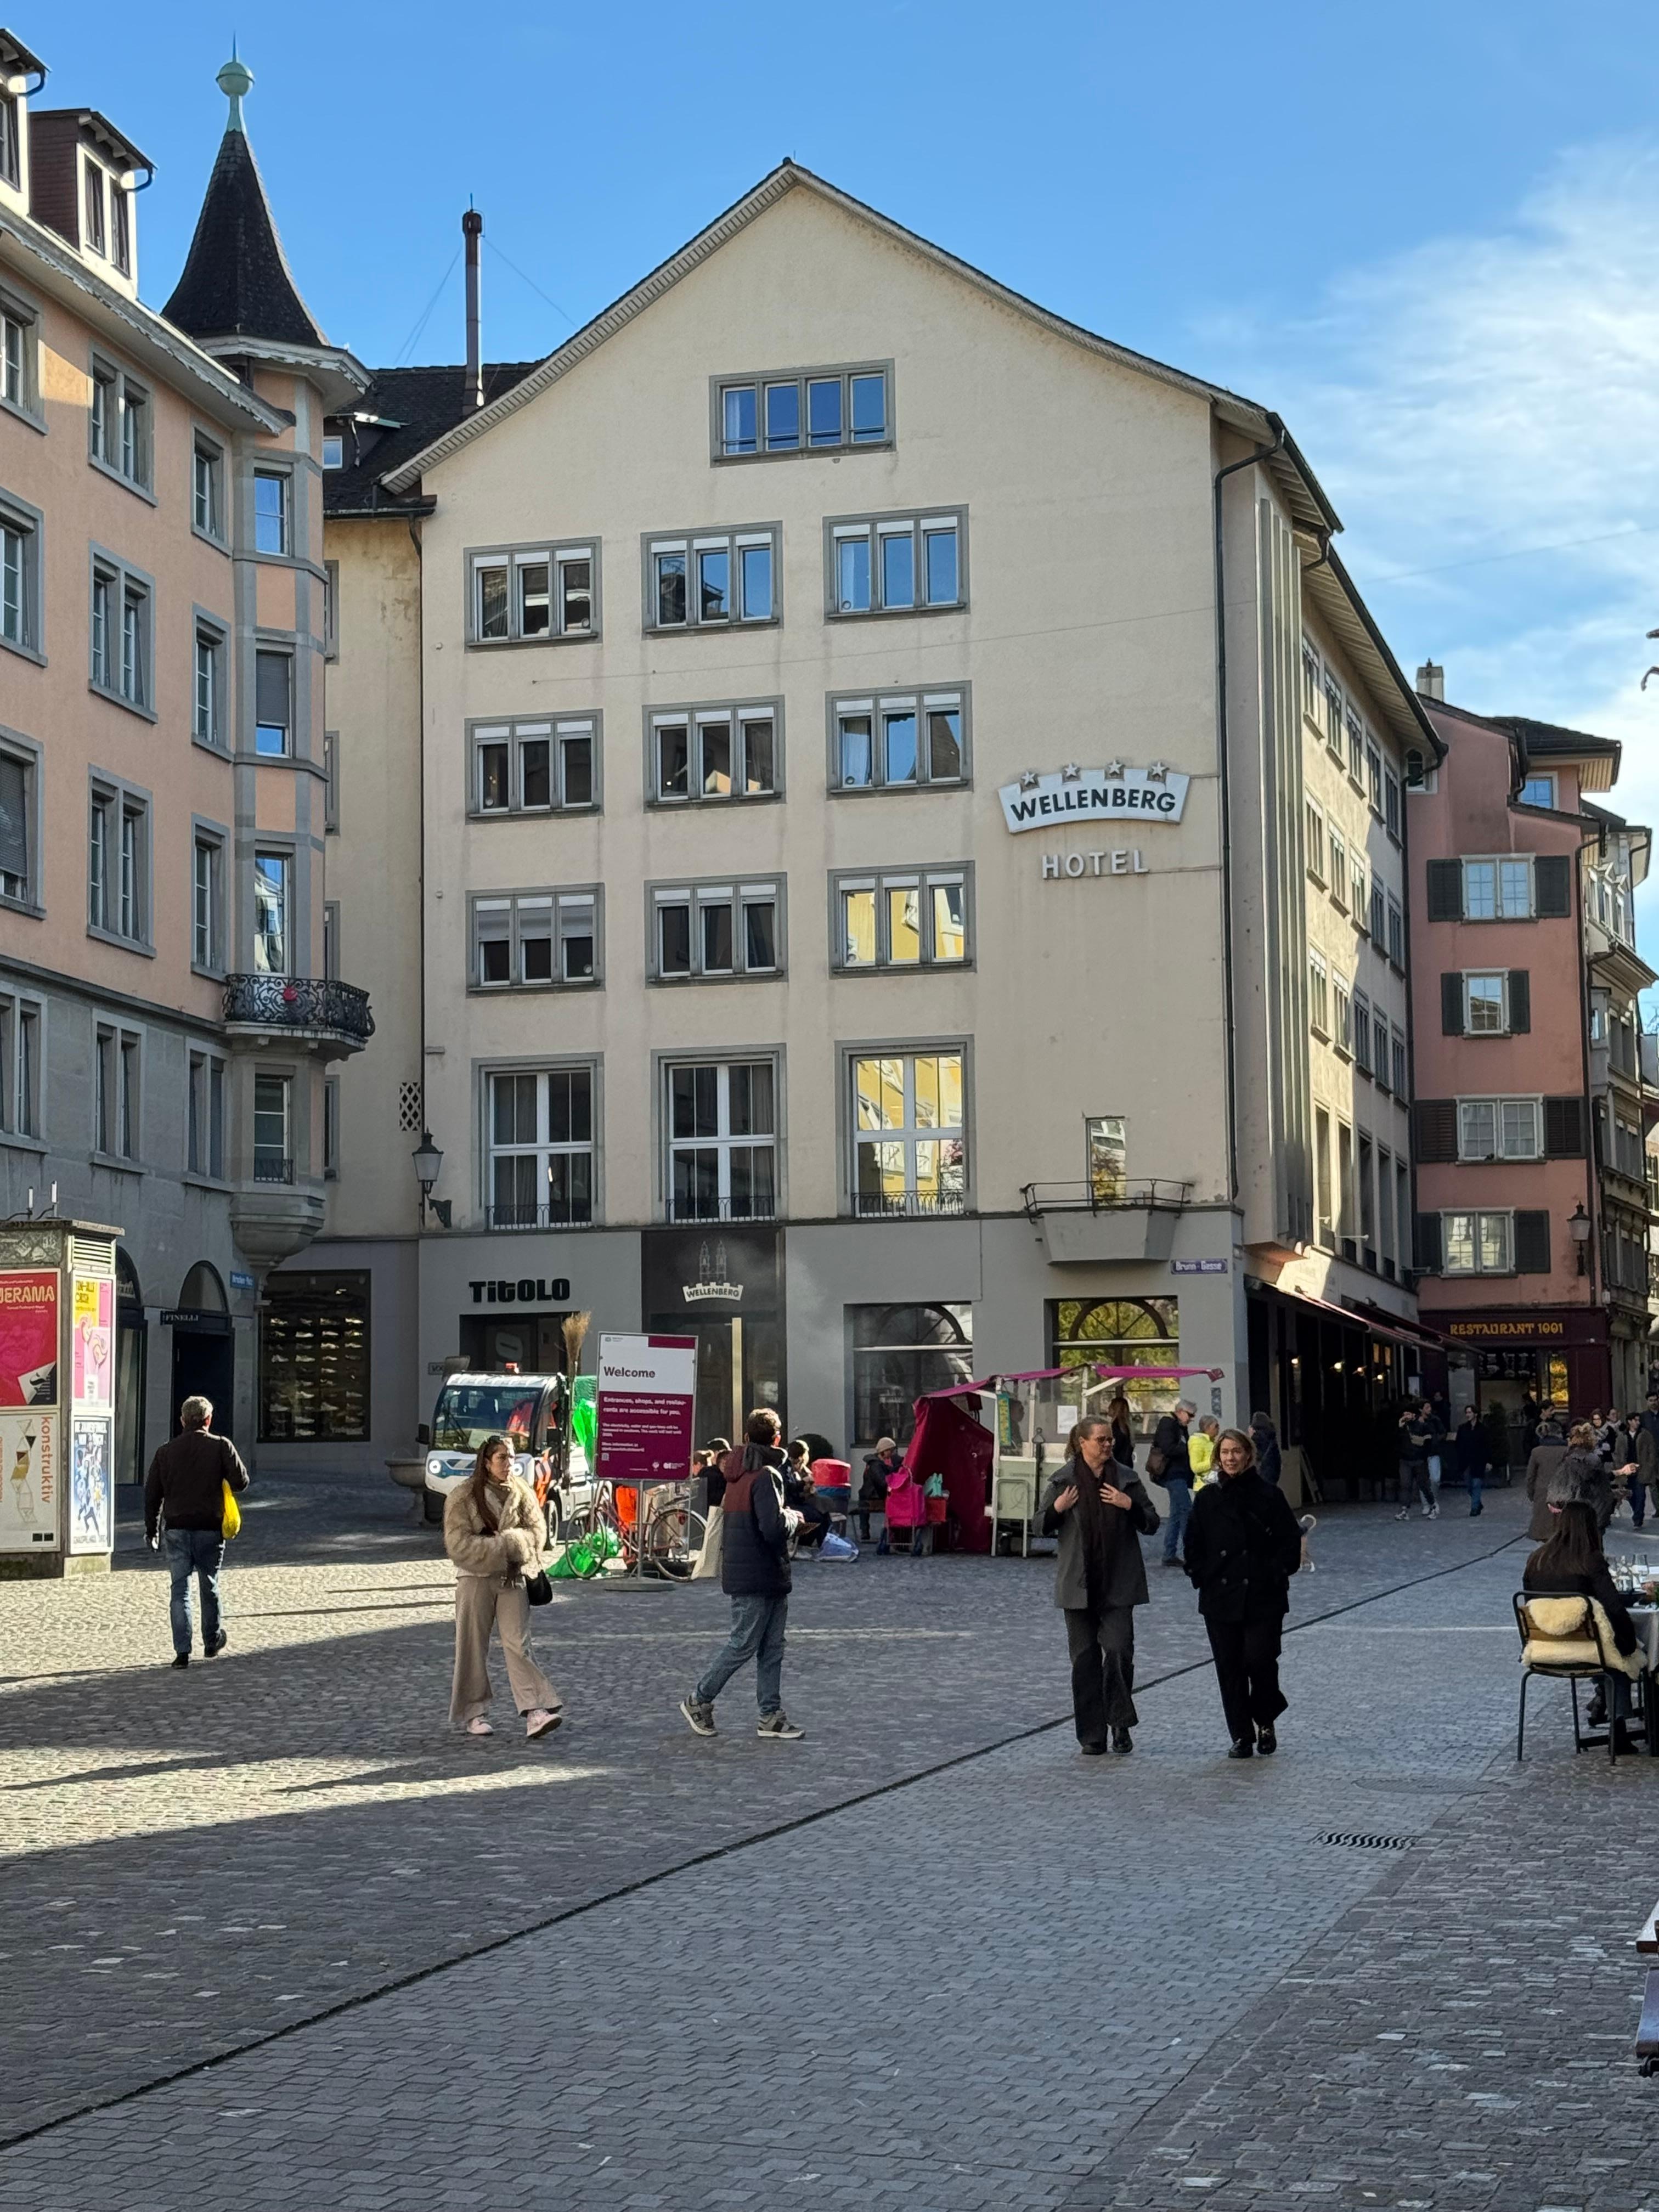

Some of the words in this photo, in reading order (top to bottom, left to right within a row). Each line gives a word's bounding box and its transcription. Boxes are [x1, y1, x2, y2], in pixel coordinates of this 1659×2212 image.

[1011, 788, 1176, 822] WELLENBERG
[1042, 849, 1149, 879] HOTEL
[686, 1288, 739, 1298] WELLENBERG
[1449, 1323, 1534, 1335] RESTAURANT
[1537, 1322, 1563, 1334] 1001
[603, 1366, 656, 1378] Welcome
[41, 1416, 54, 1503] konstruktiv
